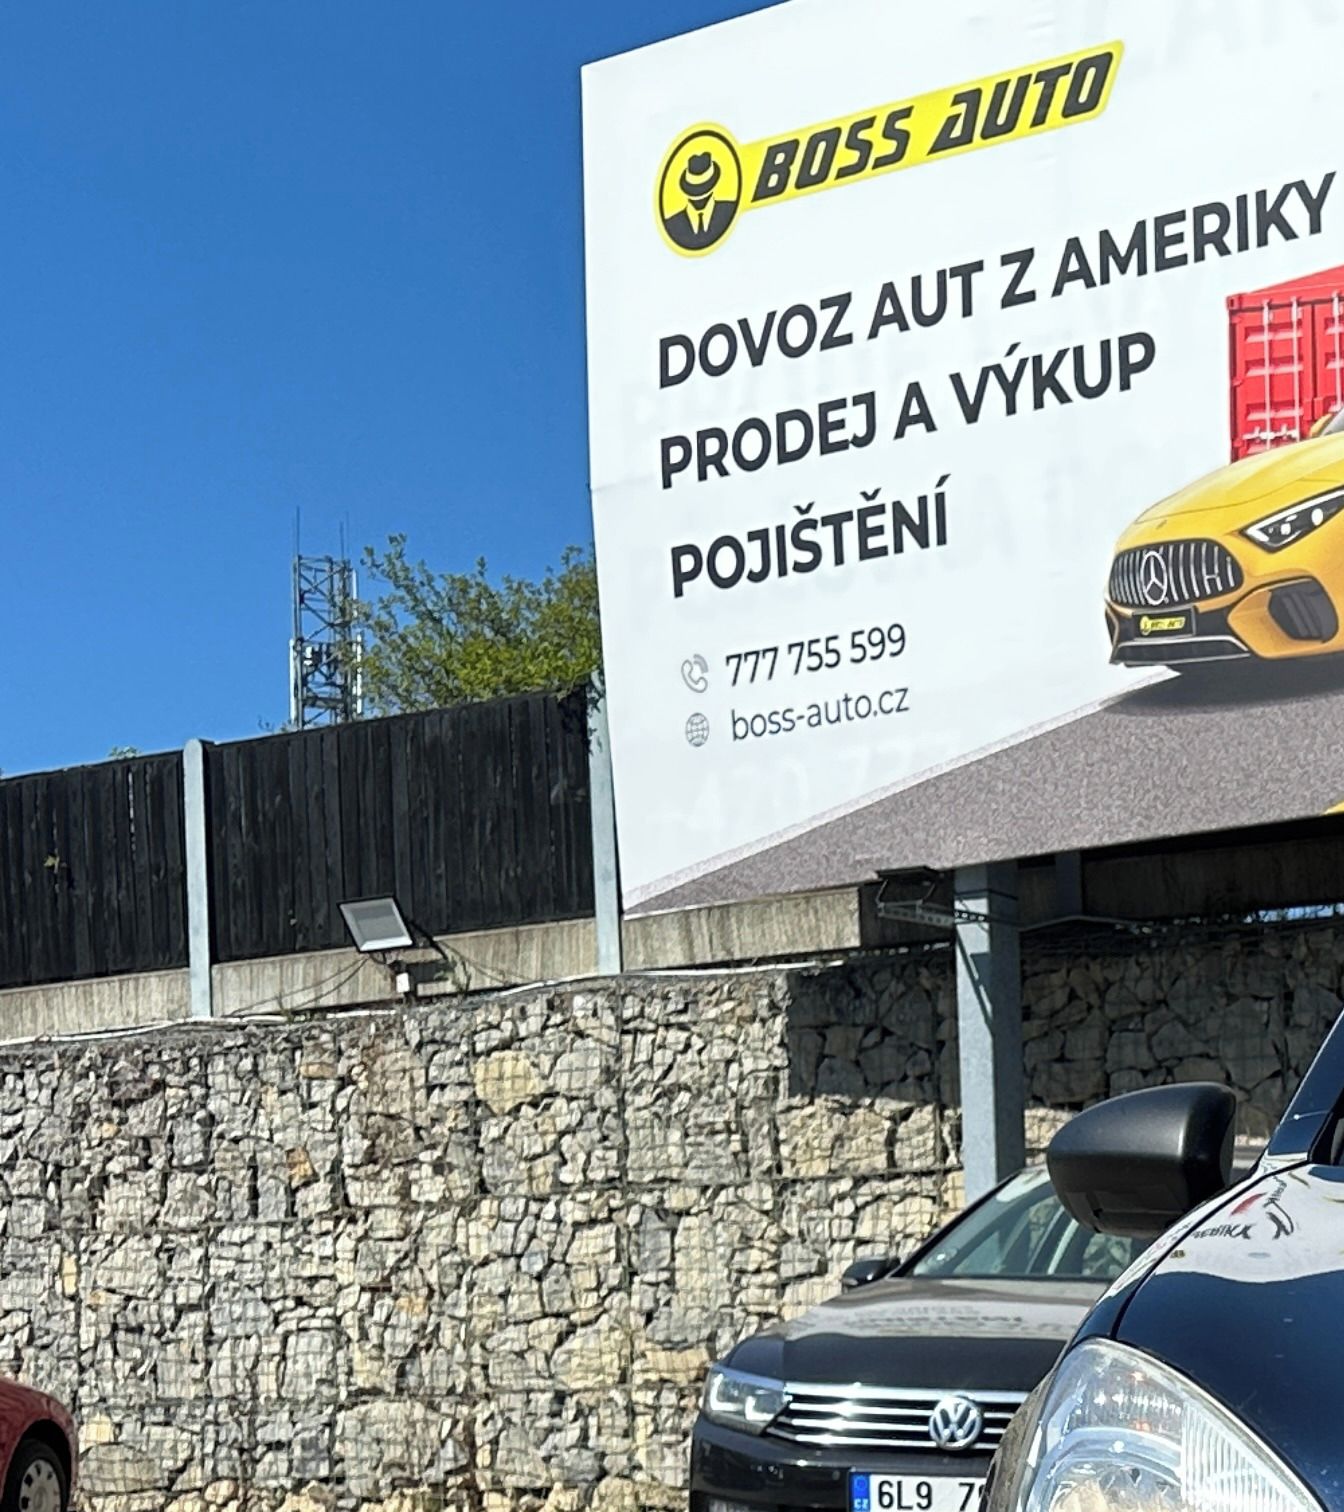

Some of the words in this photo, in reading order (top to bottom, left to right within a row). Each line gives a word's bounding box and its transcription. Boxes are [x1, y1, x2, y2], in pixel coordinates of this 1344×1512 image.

[751, 106, 914, 203] BOSS
[927, 52, 1114, 156] AUTO
[659, 291, 853, 389] DOVOZ
[867, 259, 984, 340] AUT
[1001, 248, 1036, 308] Z
[1051, 171, 1337, 298] AMERIKY
[661, 391, 876, 489] PRODEJ
[894, 381, 937, 440] A
[950, 332, 1156, 424] VÝKUP
[670, 474, 952, 598] POJIŠTĚNÍ
[725, 646, 779, 687] 777
[787, 635, 842, 676] 755
[849, 623, 907, 664] 599
[731, 687, 910, 741] boss-auto.cz
[878, 1480, 933, 1511] 6L9
